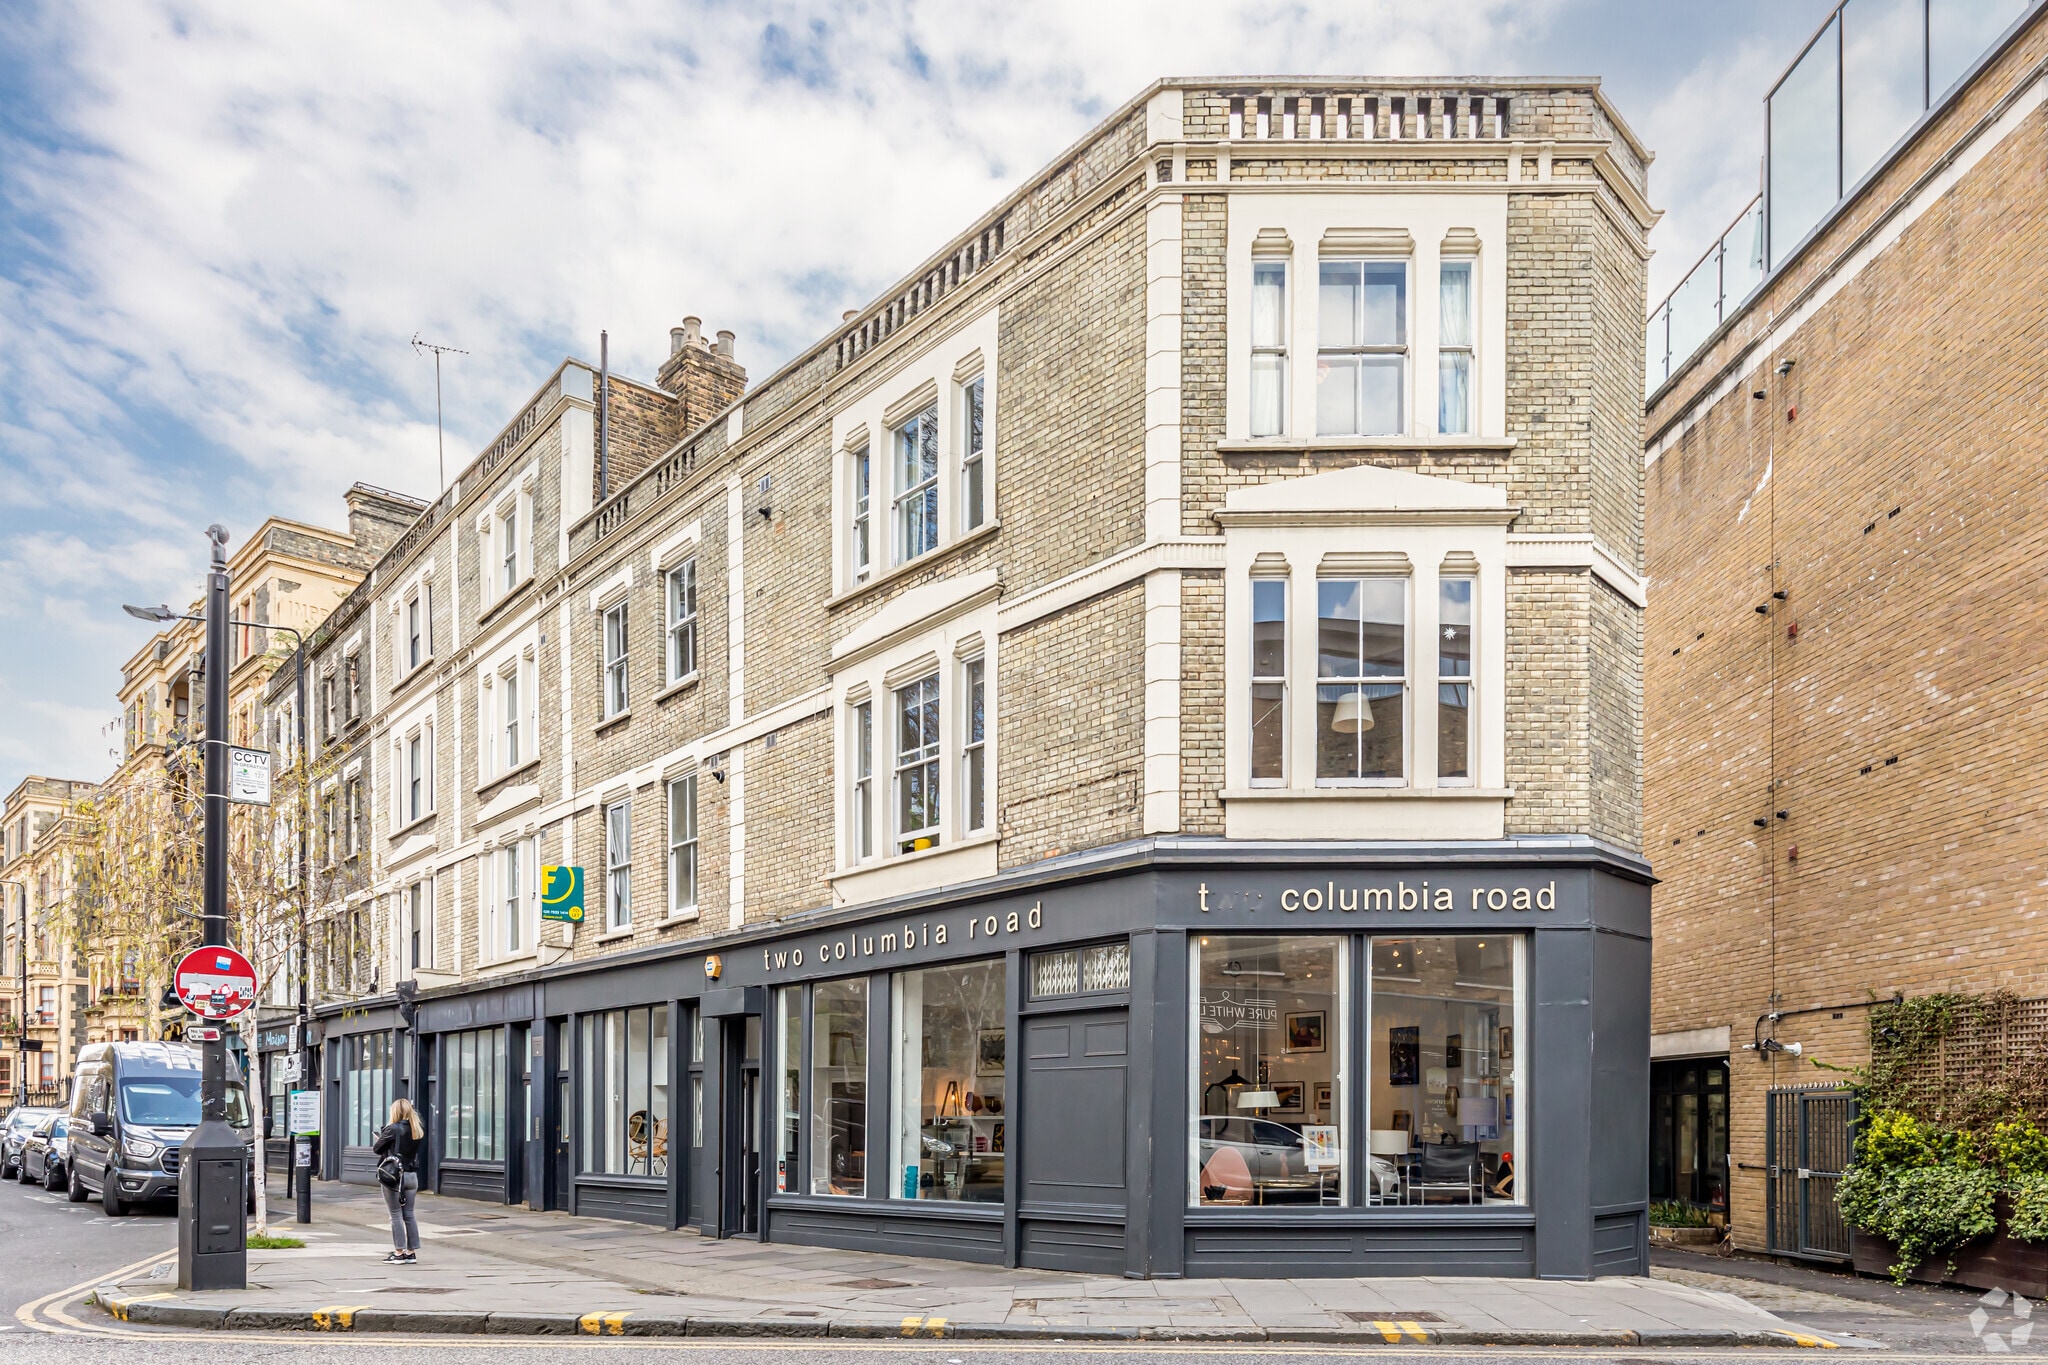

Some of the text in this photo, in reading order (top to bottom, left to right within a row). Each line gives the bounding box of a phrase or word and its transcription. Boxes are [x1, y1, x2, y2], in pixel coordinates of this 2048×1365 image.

[234, 752, 267, 765] CCTV
[240, 762, 268, 770] OPERATION
[1281, 881, 1454, 911] columbia
[1472, 881, 1556, 911] road
[764, 900, 1042, 972] two columbia road
[265, 1031, 288, 1047] Maison
